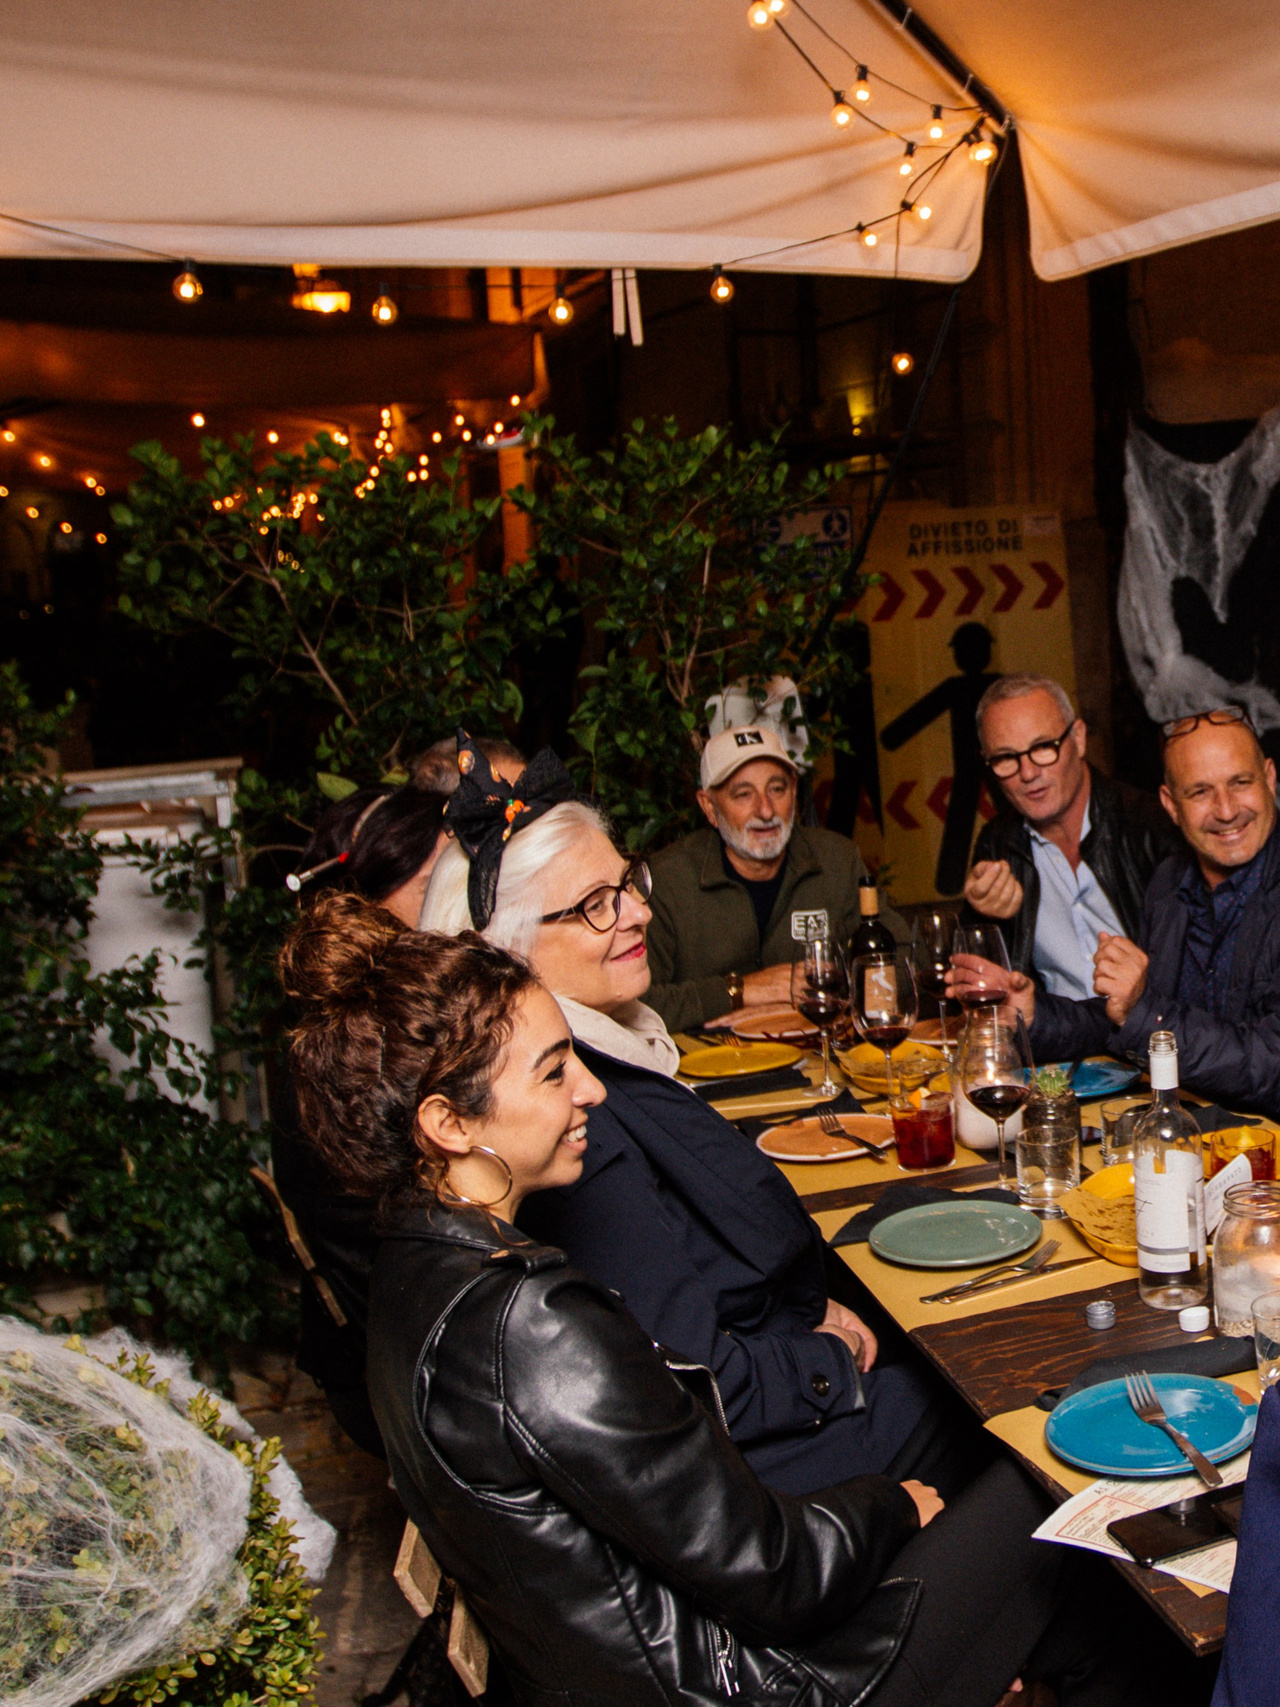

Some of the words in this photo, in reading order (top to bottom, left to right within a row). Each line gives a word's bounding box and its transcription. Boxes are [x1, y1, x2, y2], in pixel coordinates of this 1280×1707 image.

[909, 518, 989, 540] DIVIETO
[997, 517, 1019, 534] DI
[907, 534, 1023, 558] AFFISSIONE
